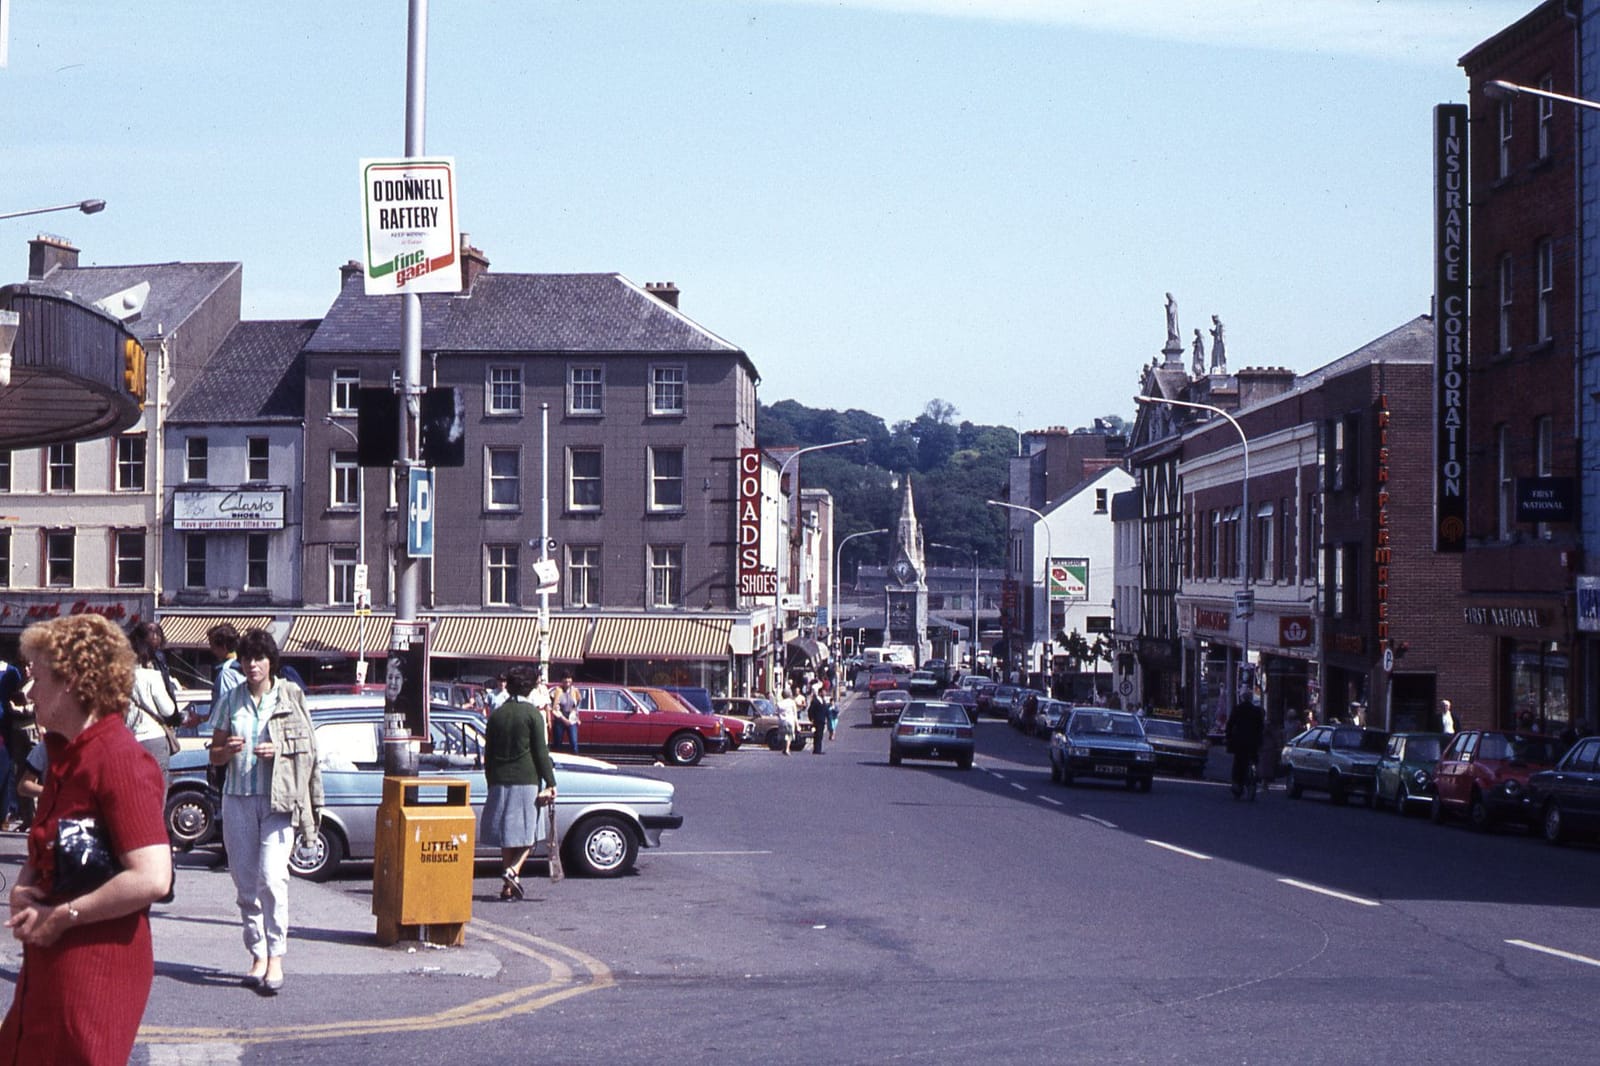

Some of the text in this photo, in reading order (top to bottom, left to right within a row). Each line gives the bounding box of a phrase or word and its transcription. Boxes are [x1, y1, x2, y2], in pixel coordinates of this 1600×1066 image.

[374, 179, 444, 202] O'DONNELL
[380, 206, 438, 230] RAFTERY
[394, 249, 425, 271] fine
[396, 257, 430, 288] gael
[1444, 116, 1461, 497] INSURANCE CORPORATION
[1378, 393, 1389, 482] IRISH
[218, 491, 274, 513] Clarks
[1522, 501, 1563, 509] NATIONAL
[1532, 490, 1555, 498] FIRST
[416, 480, 432, 548] P
[742, 454, 759, 569] COADS
[181, 520, 196, 528] Have
[199, 521, 213, 529] your
[214, 520, 241, 528] children
[262, 520, 277, 528] here
[742, 574, 777, 594] SHOES
[1463, 607, 1540, 628] FIRST NATIONAL
[421, 841, 458, 852] LITTER
